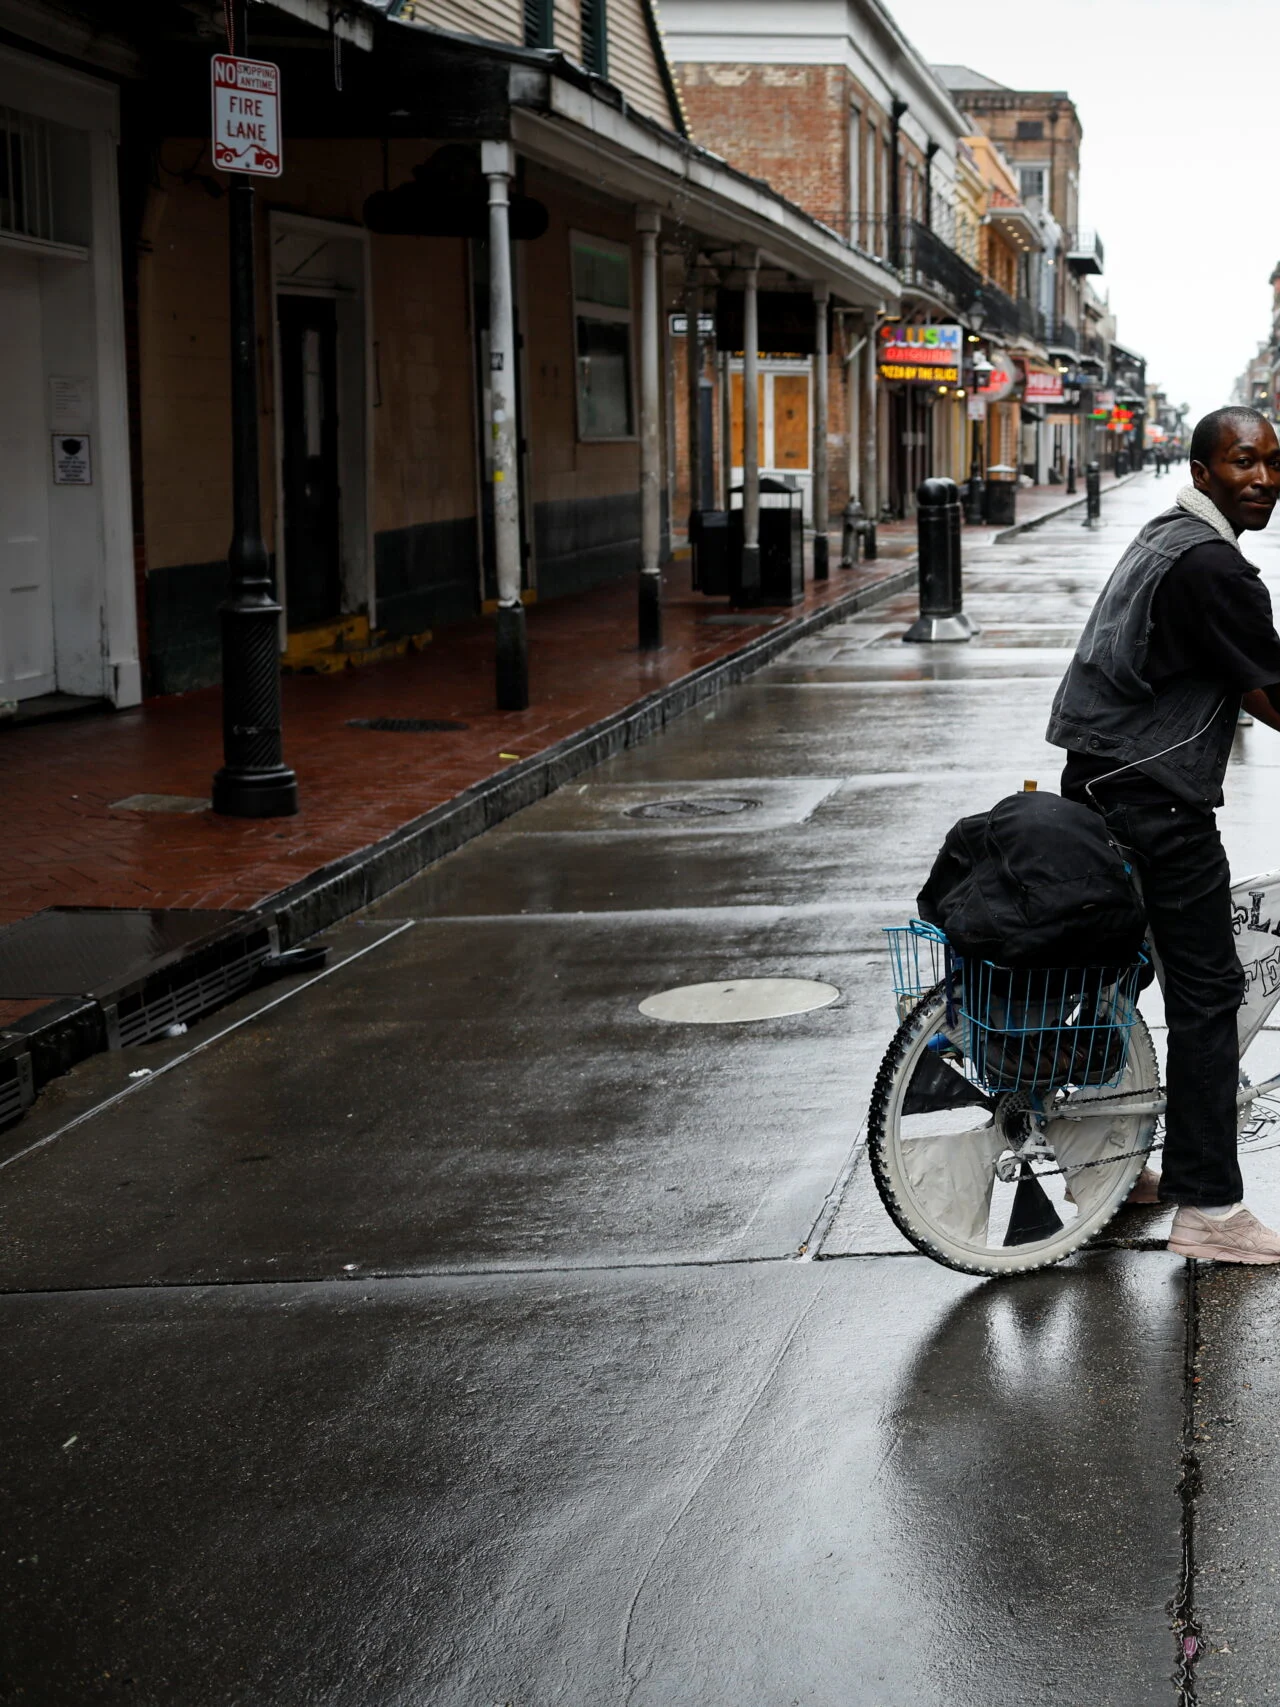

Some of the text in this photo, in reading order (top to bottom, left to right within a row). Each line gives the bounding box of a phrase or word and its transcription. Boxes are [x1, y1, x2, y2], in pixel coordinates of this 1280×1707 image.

[214, 60, 236, 84] NO
[237, 64, 275, 80] STOPPING
[240, 76, 273, 90] ANYTIME
[229, 96, 263, 117] FIRE
[226, 120, 266, 142] LANE
[881, 325, 958, 349] SLUSH
